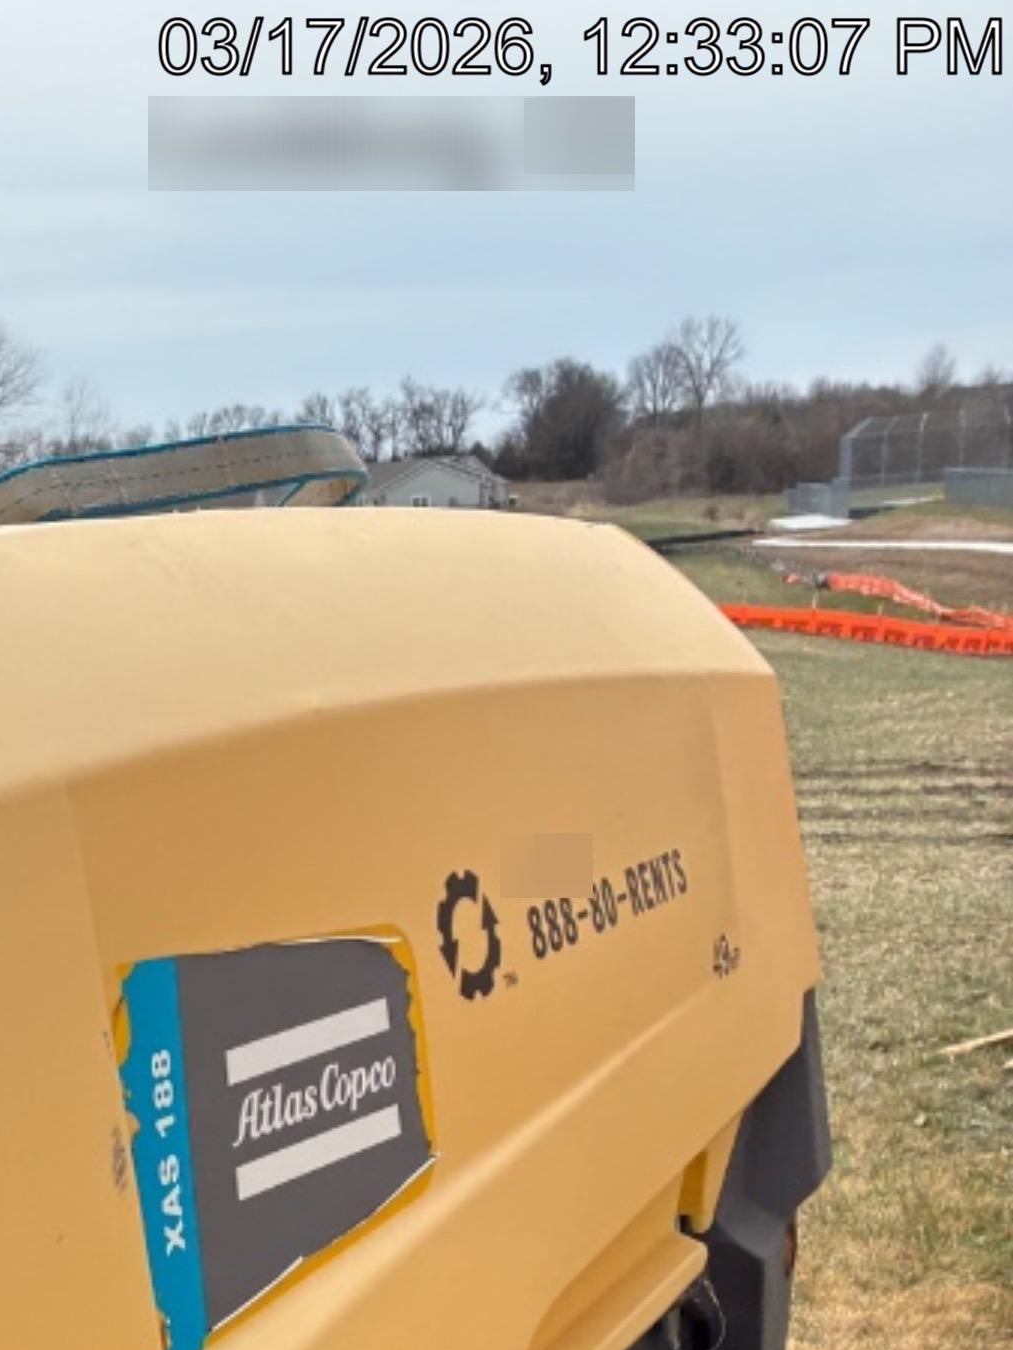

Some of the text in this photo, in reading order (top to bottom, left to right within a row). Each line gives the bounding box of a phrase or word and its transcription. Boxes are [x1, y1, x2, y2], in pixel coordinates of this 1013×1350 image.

[151, 1049, 186, 1257] XAS 188
[232, 1055, 397, 1148] Atlas Copco
